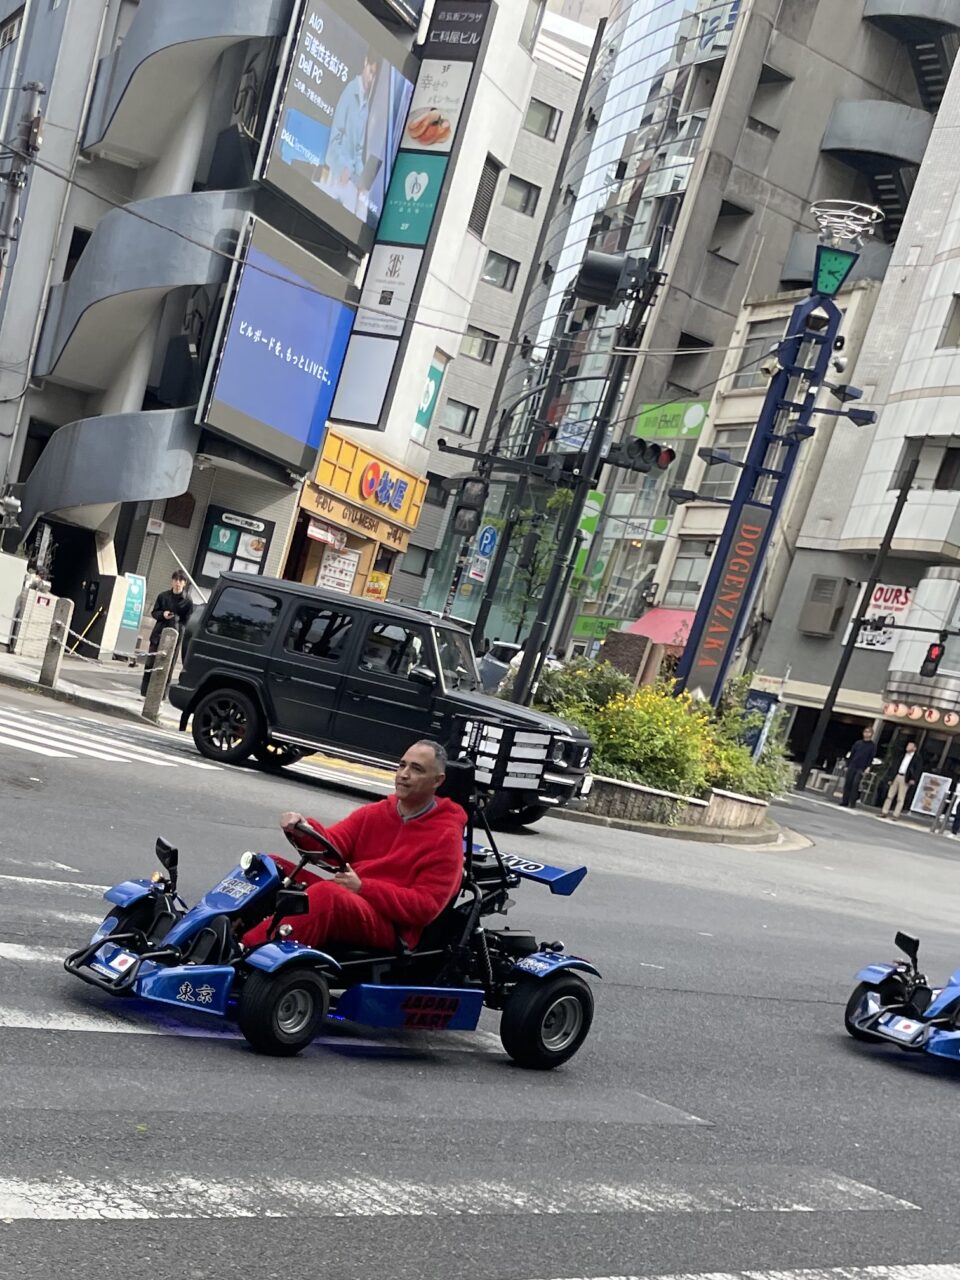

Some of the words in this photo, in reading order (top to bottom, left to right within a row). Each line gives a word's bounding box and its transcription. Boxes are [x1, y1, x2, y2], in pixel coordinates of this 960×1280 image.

[308, 12, 324, 34] AIの
[429, 30, 481, 45] 仁科屋ビル
[298, 54, 313, 76] Dell
[310, 63, 324, 85] PC
[239, 320, 331, 386] ビルボードを、もっとLIVEに。
[375, 470, 409, 512] 松屋
[342, 506, 380, 534] GYU-MESHI
[698, 523, 763, 667] DOGENZAKA
[175, 981, 216, 1004] 東京
